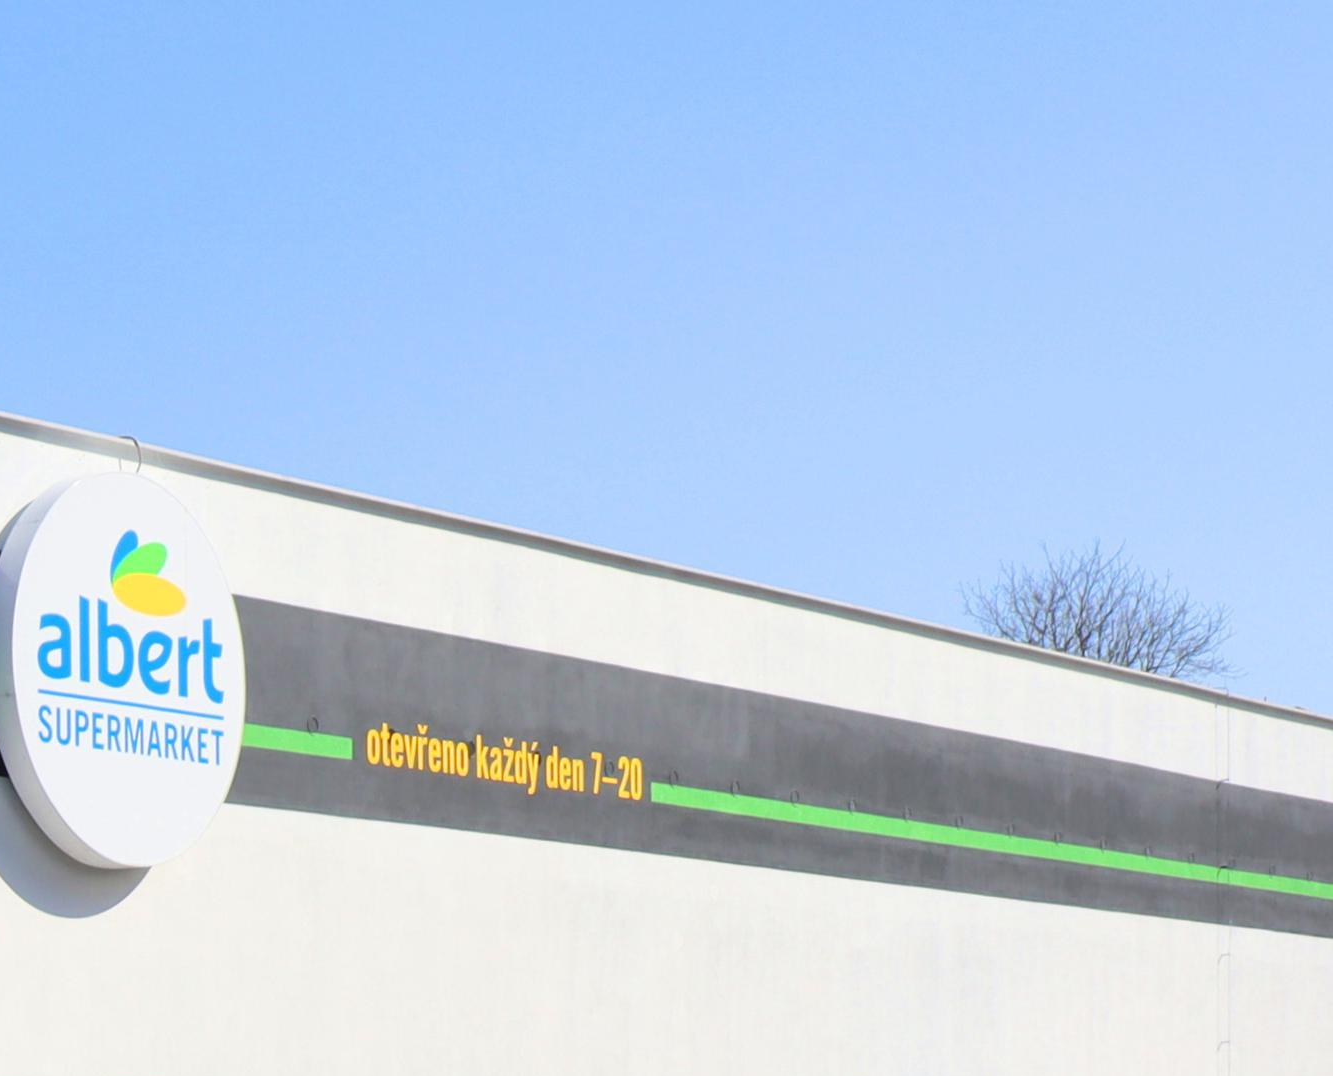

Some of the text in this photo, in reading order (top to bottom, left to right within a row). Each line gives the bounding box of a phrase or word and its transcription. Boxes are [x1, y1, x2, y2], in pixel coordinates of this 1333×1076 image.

[37, 595, 225, 705] albert
[37, 704, 225, 766] SUPERMARKET
[366, 722, 470, 778] otevřeno
[475, 734, 540, 795] každý
[545, 745, 585, 792] den
